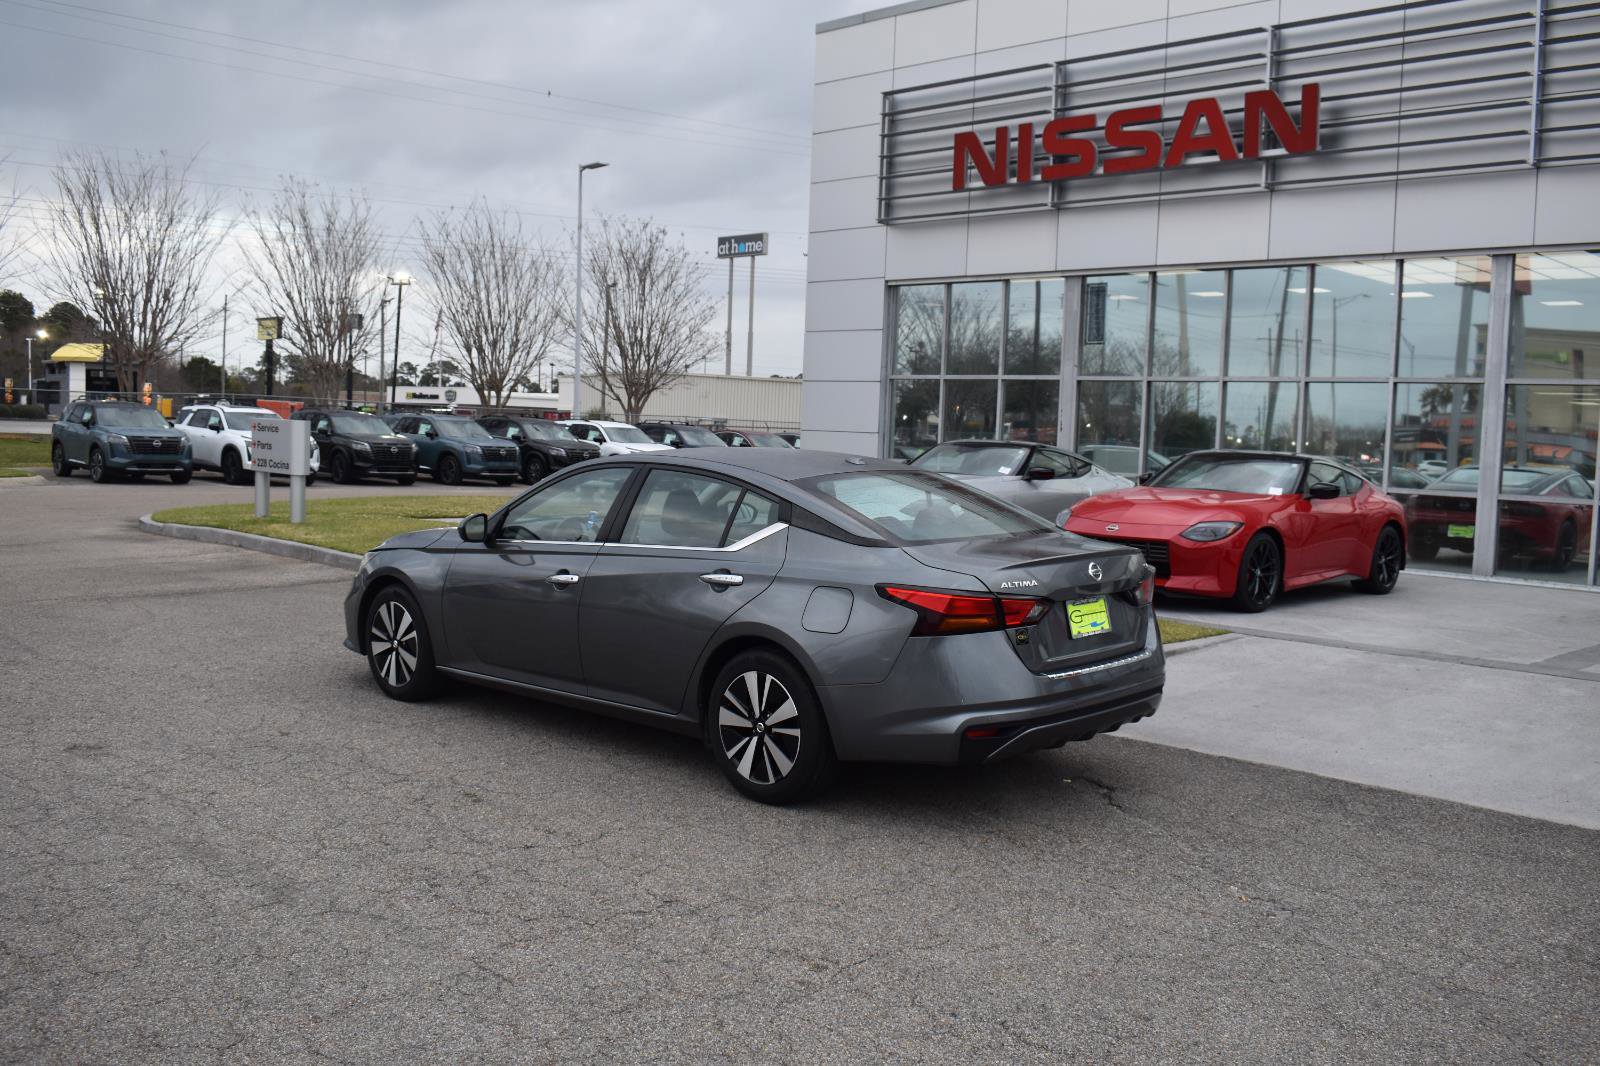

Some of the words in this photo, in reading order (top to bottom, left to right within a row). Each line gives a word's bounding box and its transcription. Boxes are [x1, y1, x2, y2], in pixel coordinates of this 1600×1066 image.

[952, 82, 1321, 192] NISSAN
[718, 241, 730, 255] at
[731, 238, 763, 254] home
[257, 423, 279, 433] Service
[257, 441, 272, 450] Parts
[257, 459, 267, 467] 228
[268, 459, 289, 469] Cocina
[1000, 580, 1038, 589] ALTIMA
